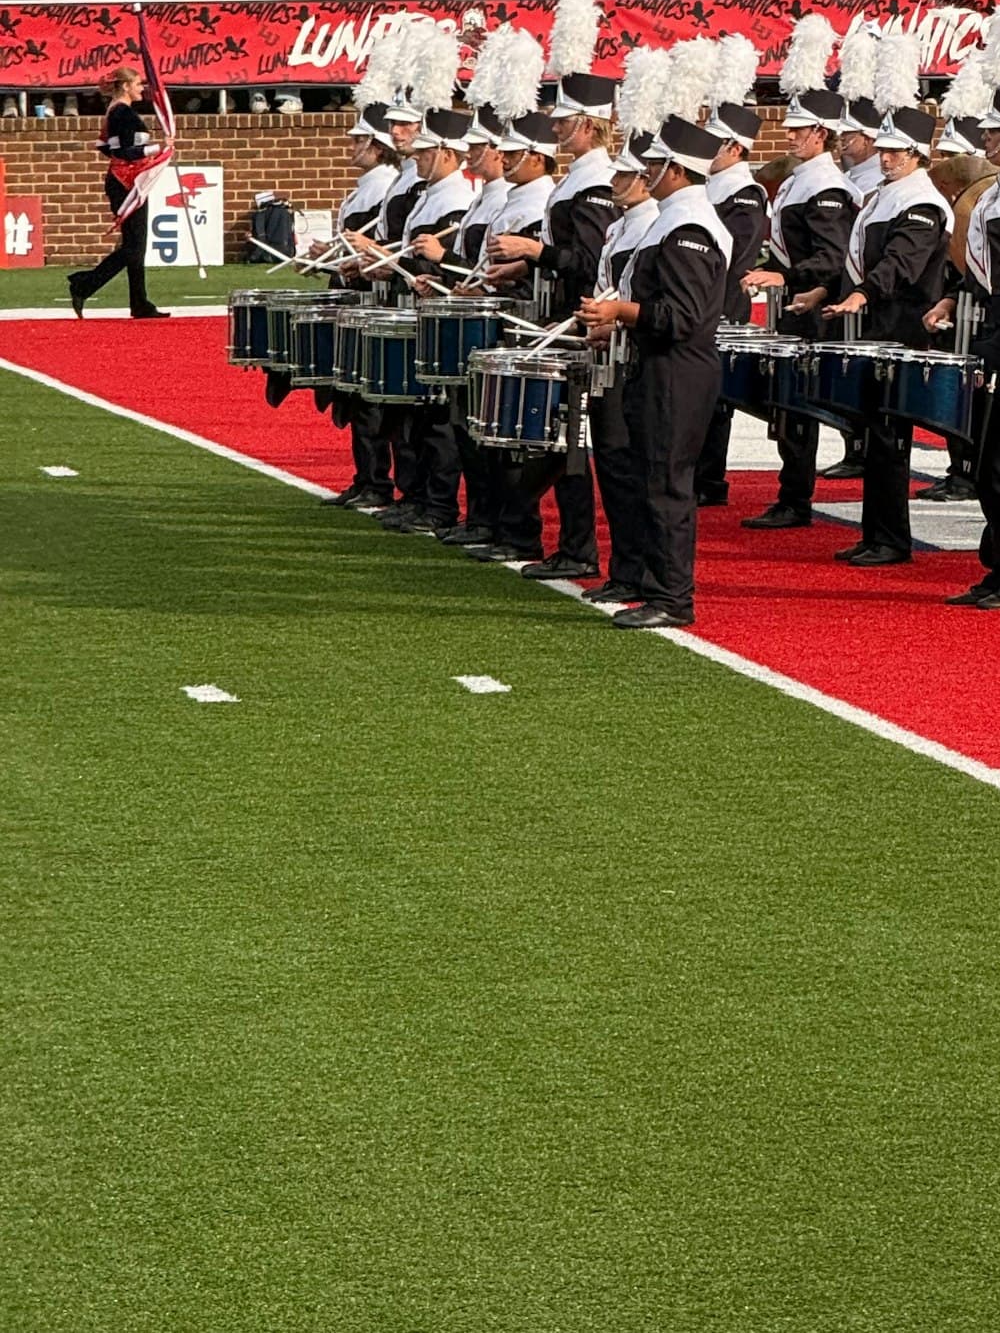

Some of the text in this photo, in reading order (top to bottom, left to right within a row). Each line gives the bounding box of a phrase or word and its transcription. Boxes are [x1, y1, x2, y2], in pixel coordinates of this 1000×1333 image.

[58, 43, 123, 78] LUNATICS
[158, 41, 223, 76] LUNATICS
[817, 199, 844, 209] LIBERTY
[907, 212, 935, 226] LIBERTY
[150, 213, 179, 264] UP
[677, 239, 711, 254] LIBERTY
